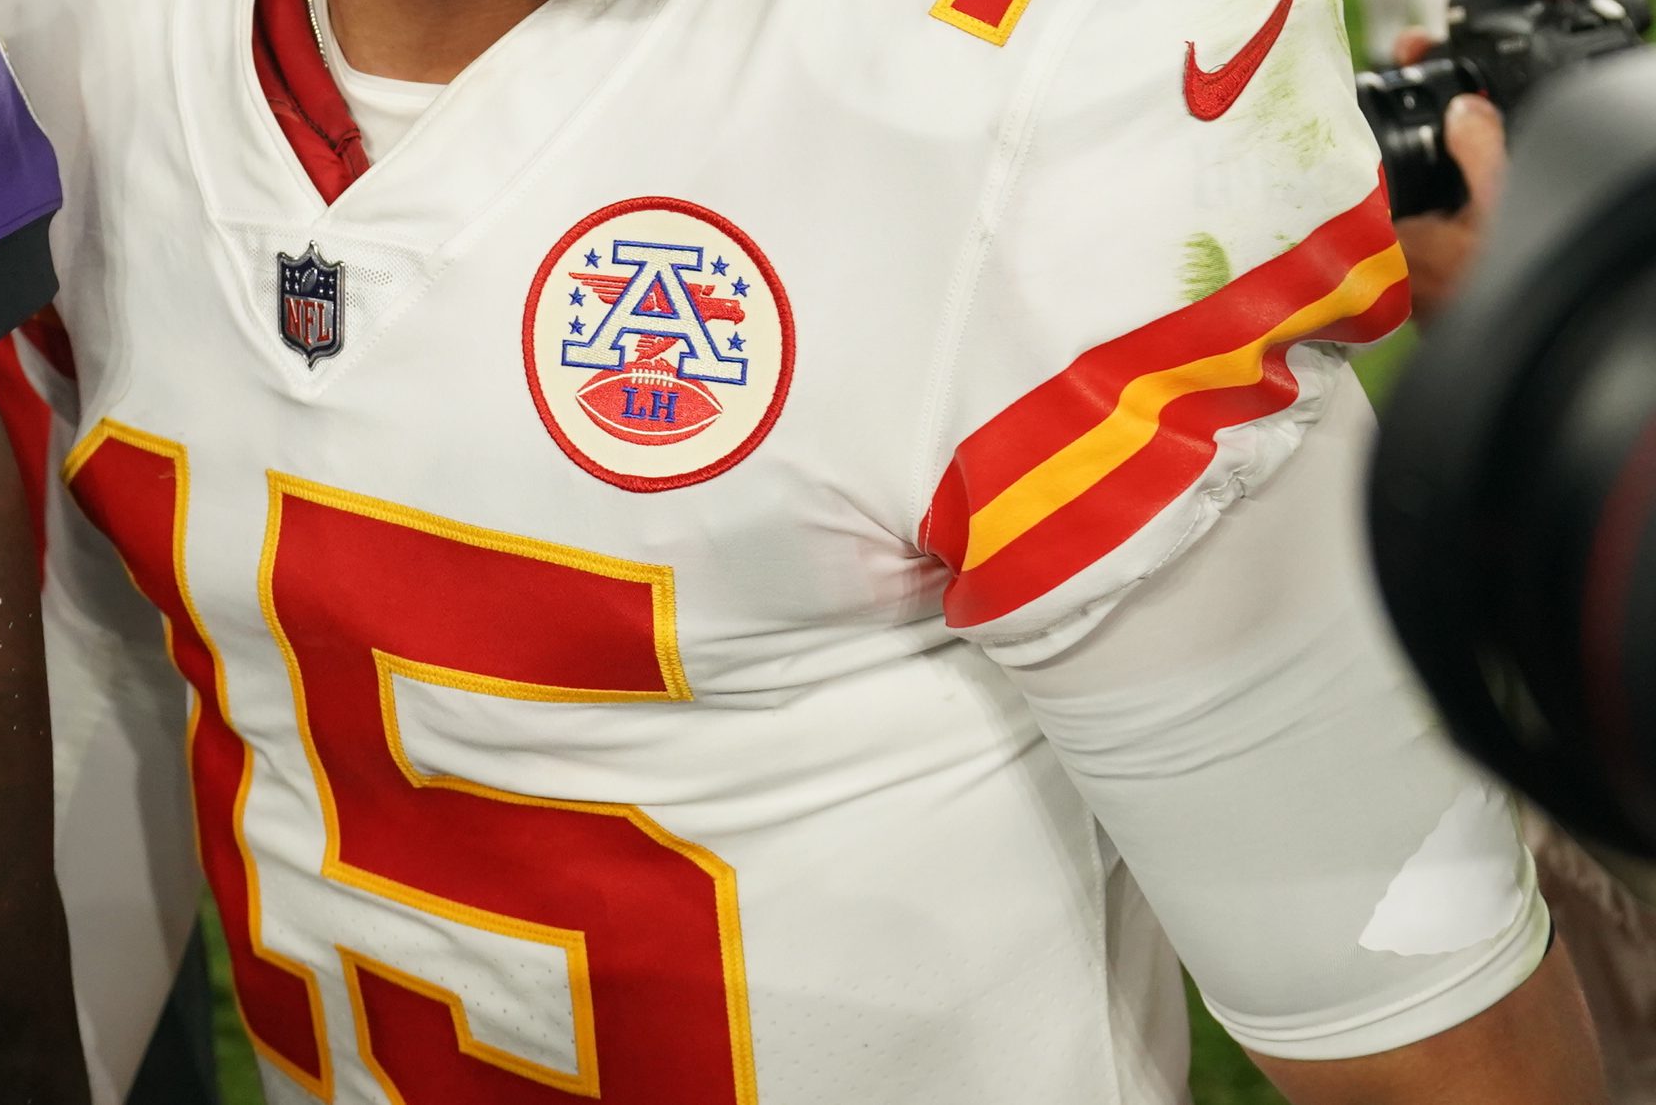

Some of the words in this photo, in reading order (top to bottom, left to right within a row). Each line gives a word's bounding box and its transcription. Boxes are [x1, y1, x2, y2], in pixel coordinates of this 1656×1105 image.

[285, 296, 332, 346] NFL
[561, 239, 749, 385] A
[621, 386, 679, 424] LH
[61, 416, 758, 1105] 15
